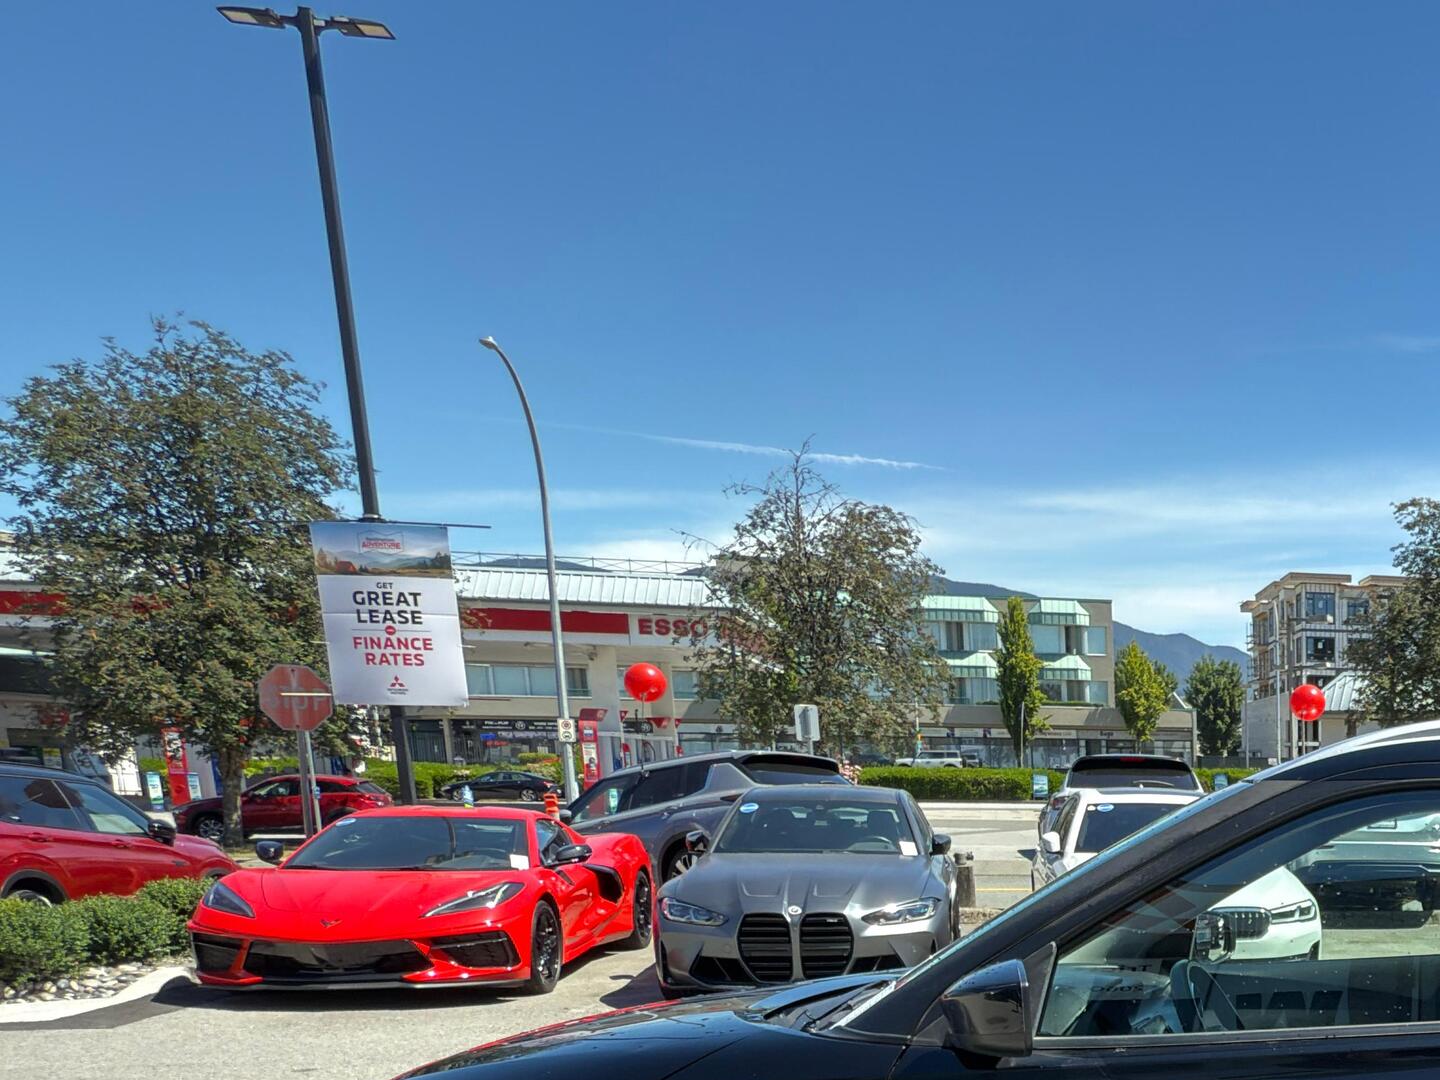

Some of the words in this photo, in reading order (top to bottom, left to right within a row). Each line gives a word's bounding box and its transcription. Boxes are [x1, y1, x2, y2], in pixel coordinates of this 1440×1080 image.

[376, 581, 393, 590] GET
[352, 590, 422, 607] GREAT
[356, 609, 423, 625] LEASE
[637, 617, 709, 638] ESSO
[352, 636, 433, 651] FINANCE
[365, 652, 425, 666] RATES
[267, 684, 327, 711] STOP
